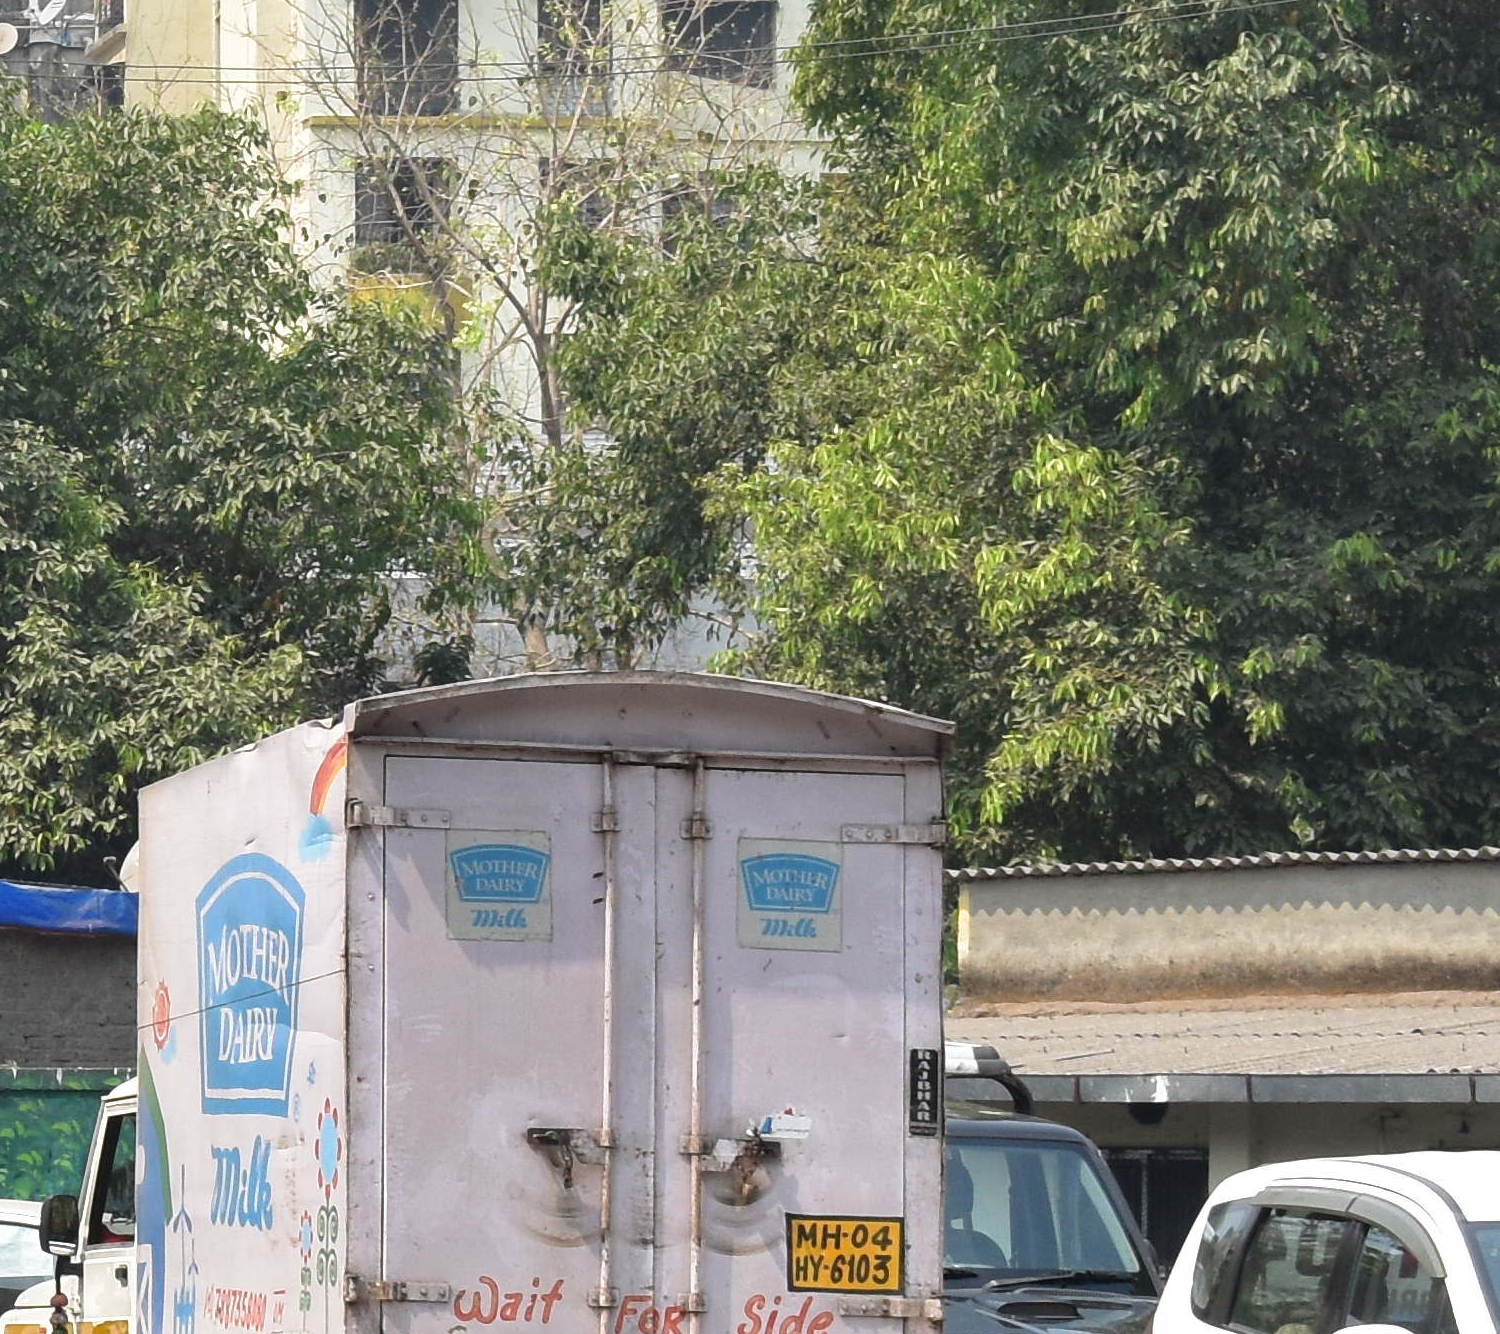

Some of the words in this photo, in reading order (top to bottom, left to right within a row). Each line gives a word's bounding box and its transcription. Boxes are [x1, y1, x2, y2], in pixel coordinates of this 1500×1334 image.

[460, 856, 540, 880] MOTHER
[751, 866, 831, 891] MOTHER
[474, 876, 525, 894] DAIRY
[765, 886, 816, 902] DAIRY
[470, 908, 528, 929] Milk
[760, 918, 818, 940] Milk
[204, 924, 292, 1009] MOTHER
[217, 1005, 277, 1066] DAIRY
[916, 1050, 932, 1122] RAJBHAR
[209, 1134, 275, 1233] Milk
[795, 1224, 894, 1252] MH-04
[794, 1255, 894, 1287] HY-6103
[453, 1276, 564, 1325] Wait
